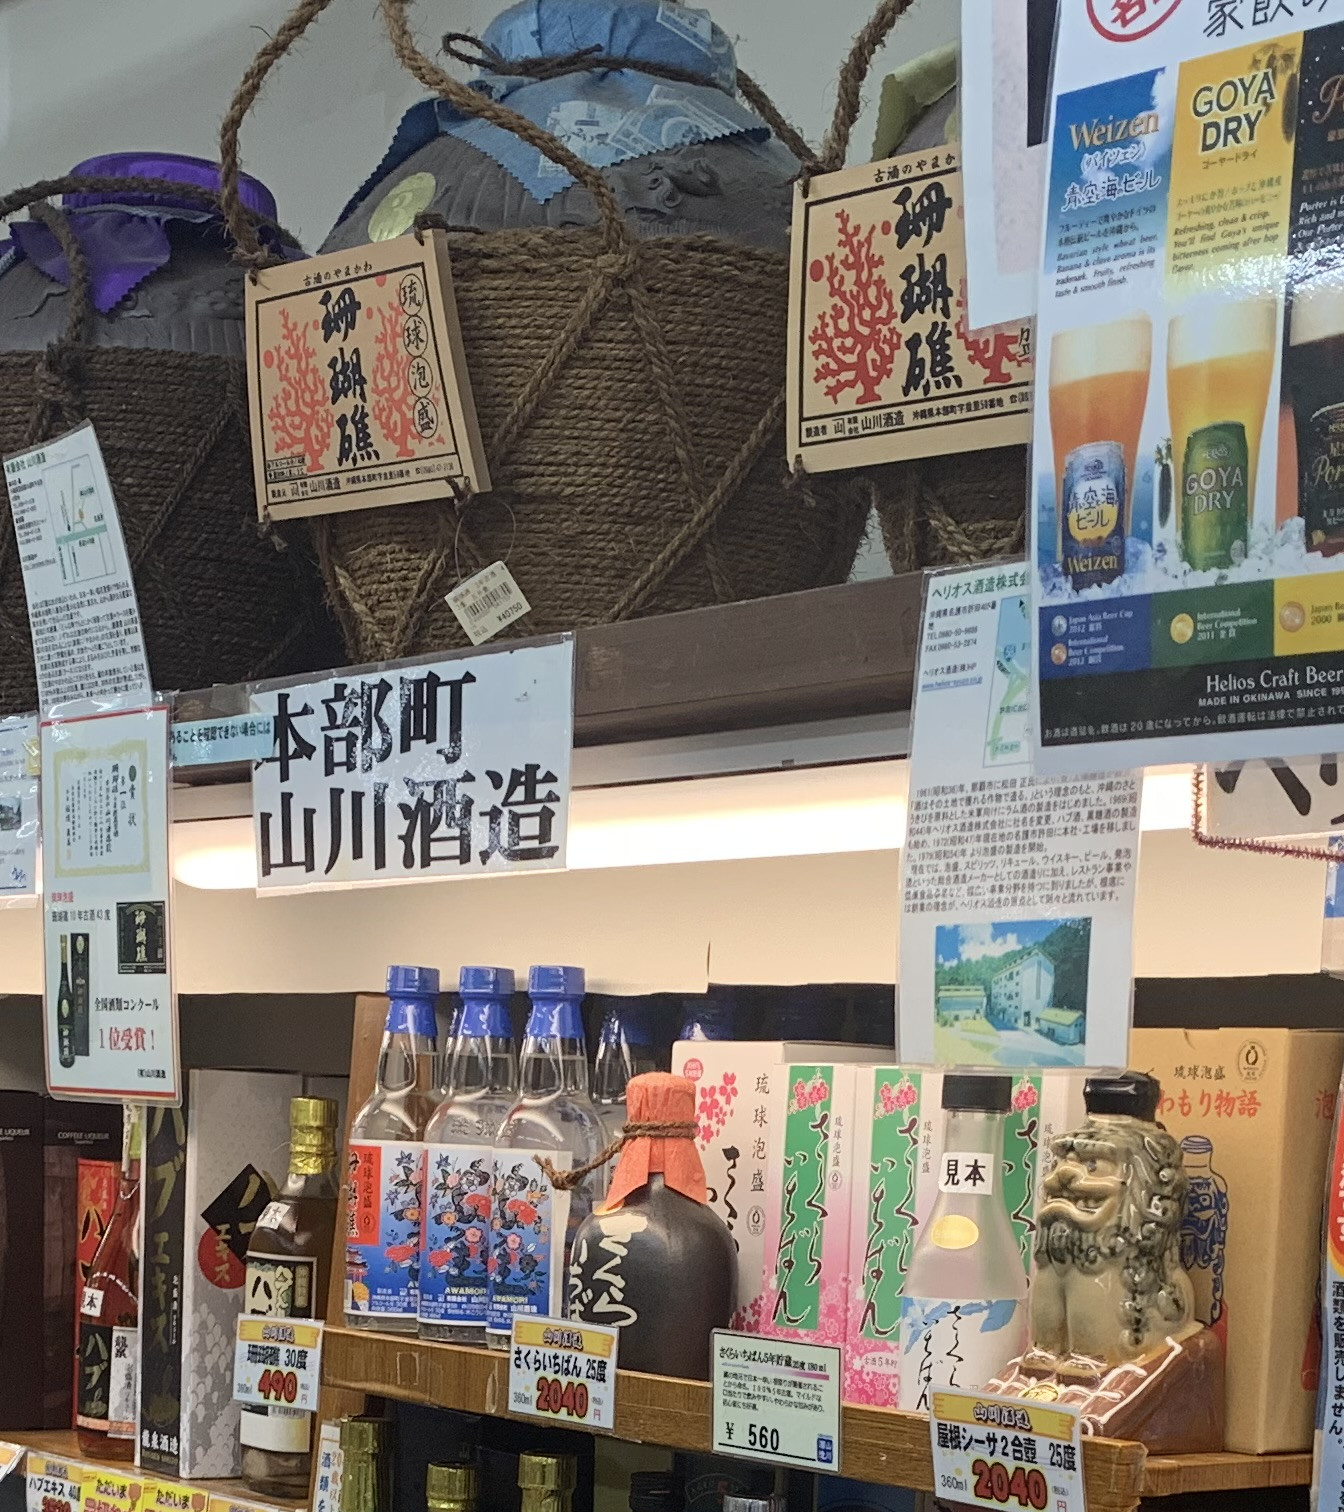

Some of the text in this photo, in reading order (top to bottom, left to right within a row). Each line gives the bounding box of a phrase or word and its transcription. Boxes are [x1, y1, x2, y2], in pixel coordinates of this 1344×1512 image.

[1192, 71, 1276, 117] GOYA
[1069, 114, 1159, 150] Weizen
[1201, 111, 1264, 152] DRY
[399, 274, 438, 439] 琉球泡盛
[1186, 466, 1244, 494] GOYA
[1194, 490, 1234, 514] DRY
[1207, 666, 1344, 693] Helios Craft Beer
[1199, 696, 1227, 708] MADE
[1229, 695, 1240, 704] IN
[1243, 691, 1290, 703] OKINAWA
[1297, 688, 1327, 698] SINCE
[255, 669, 476, 782] 本部町
[258, 763, 561, 878] 山川酒造
[1173, 1063, 1227, 1082] 琉球泡盛
[944, 1157, 987, 1188] 見本
[748, 1422, 780, 1451] 560
[972, 1459, 1048, 1511] 2040
